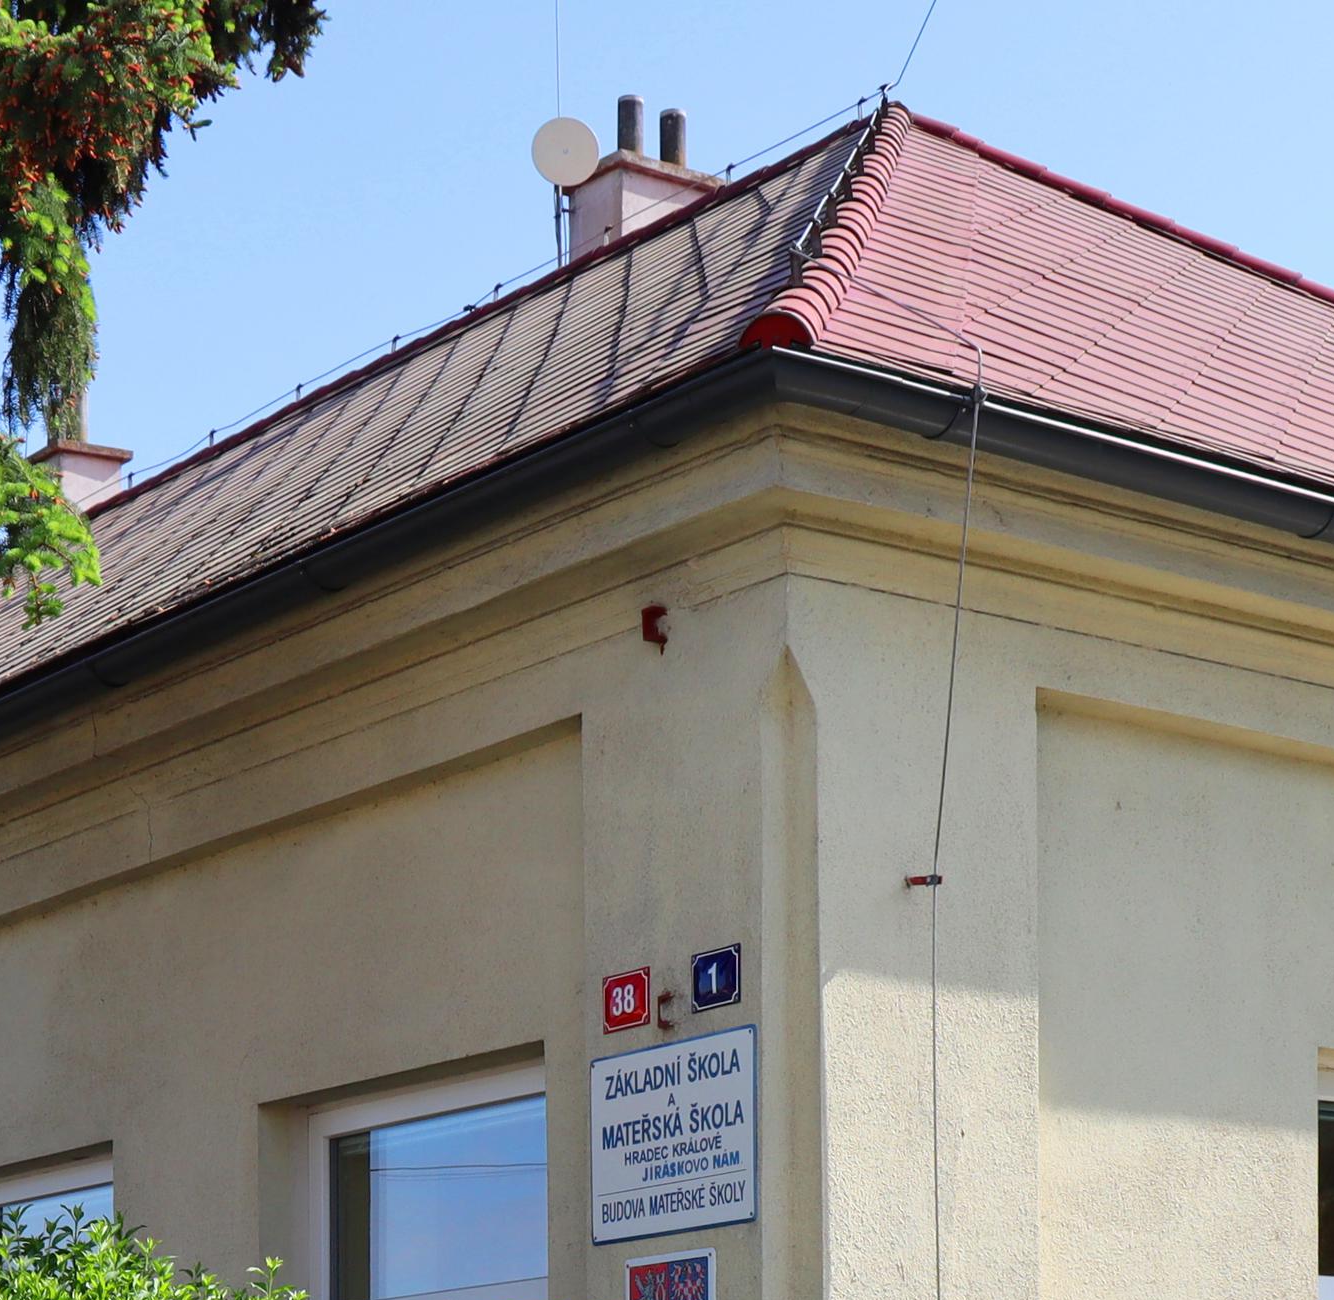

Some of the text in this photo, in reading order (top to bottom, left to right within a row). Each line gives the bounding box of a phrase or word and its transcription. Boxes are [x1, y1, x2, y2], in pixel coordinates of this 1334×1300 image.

[708, 962, 718, 994] 1
[612, 984, 635, 1016] 38
[605, 1048, 741, 1100] ZÁKLADNÍ ŠKOLA
[668, 1093, 676, 1106] A
[602, 1099, 744, 1150] MATEŘSKÁ ŠKOLA
[624, 1133, 723, 1166] HRADEC KRÁLOVÉ
[602, 1180, 746, 1224] BUDOVA MATEŘSKÉ ŠKOLY
